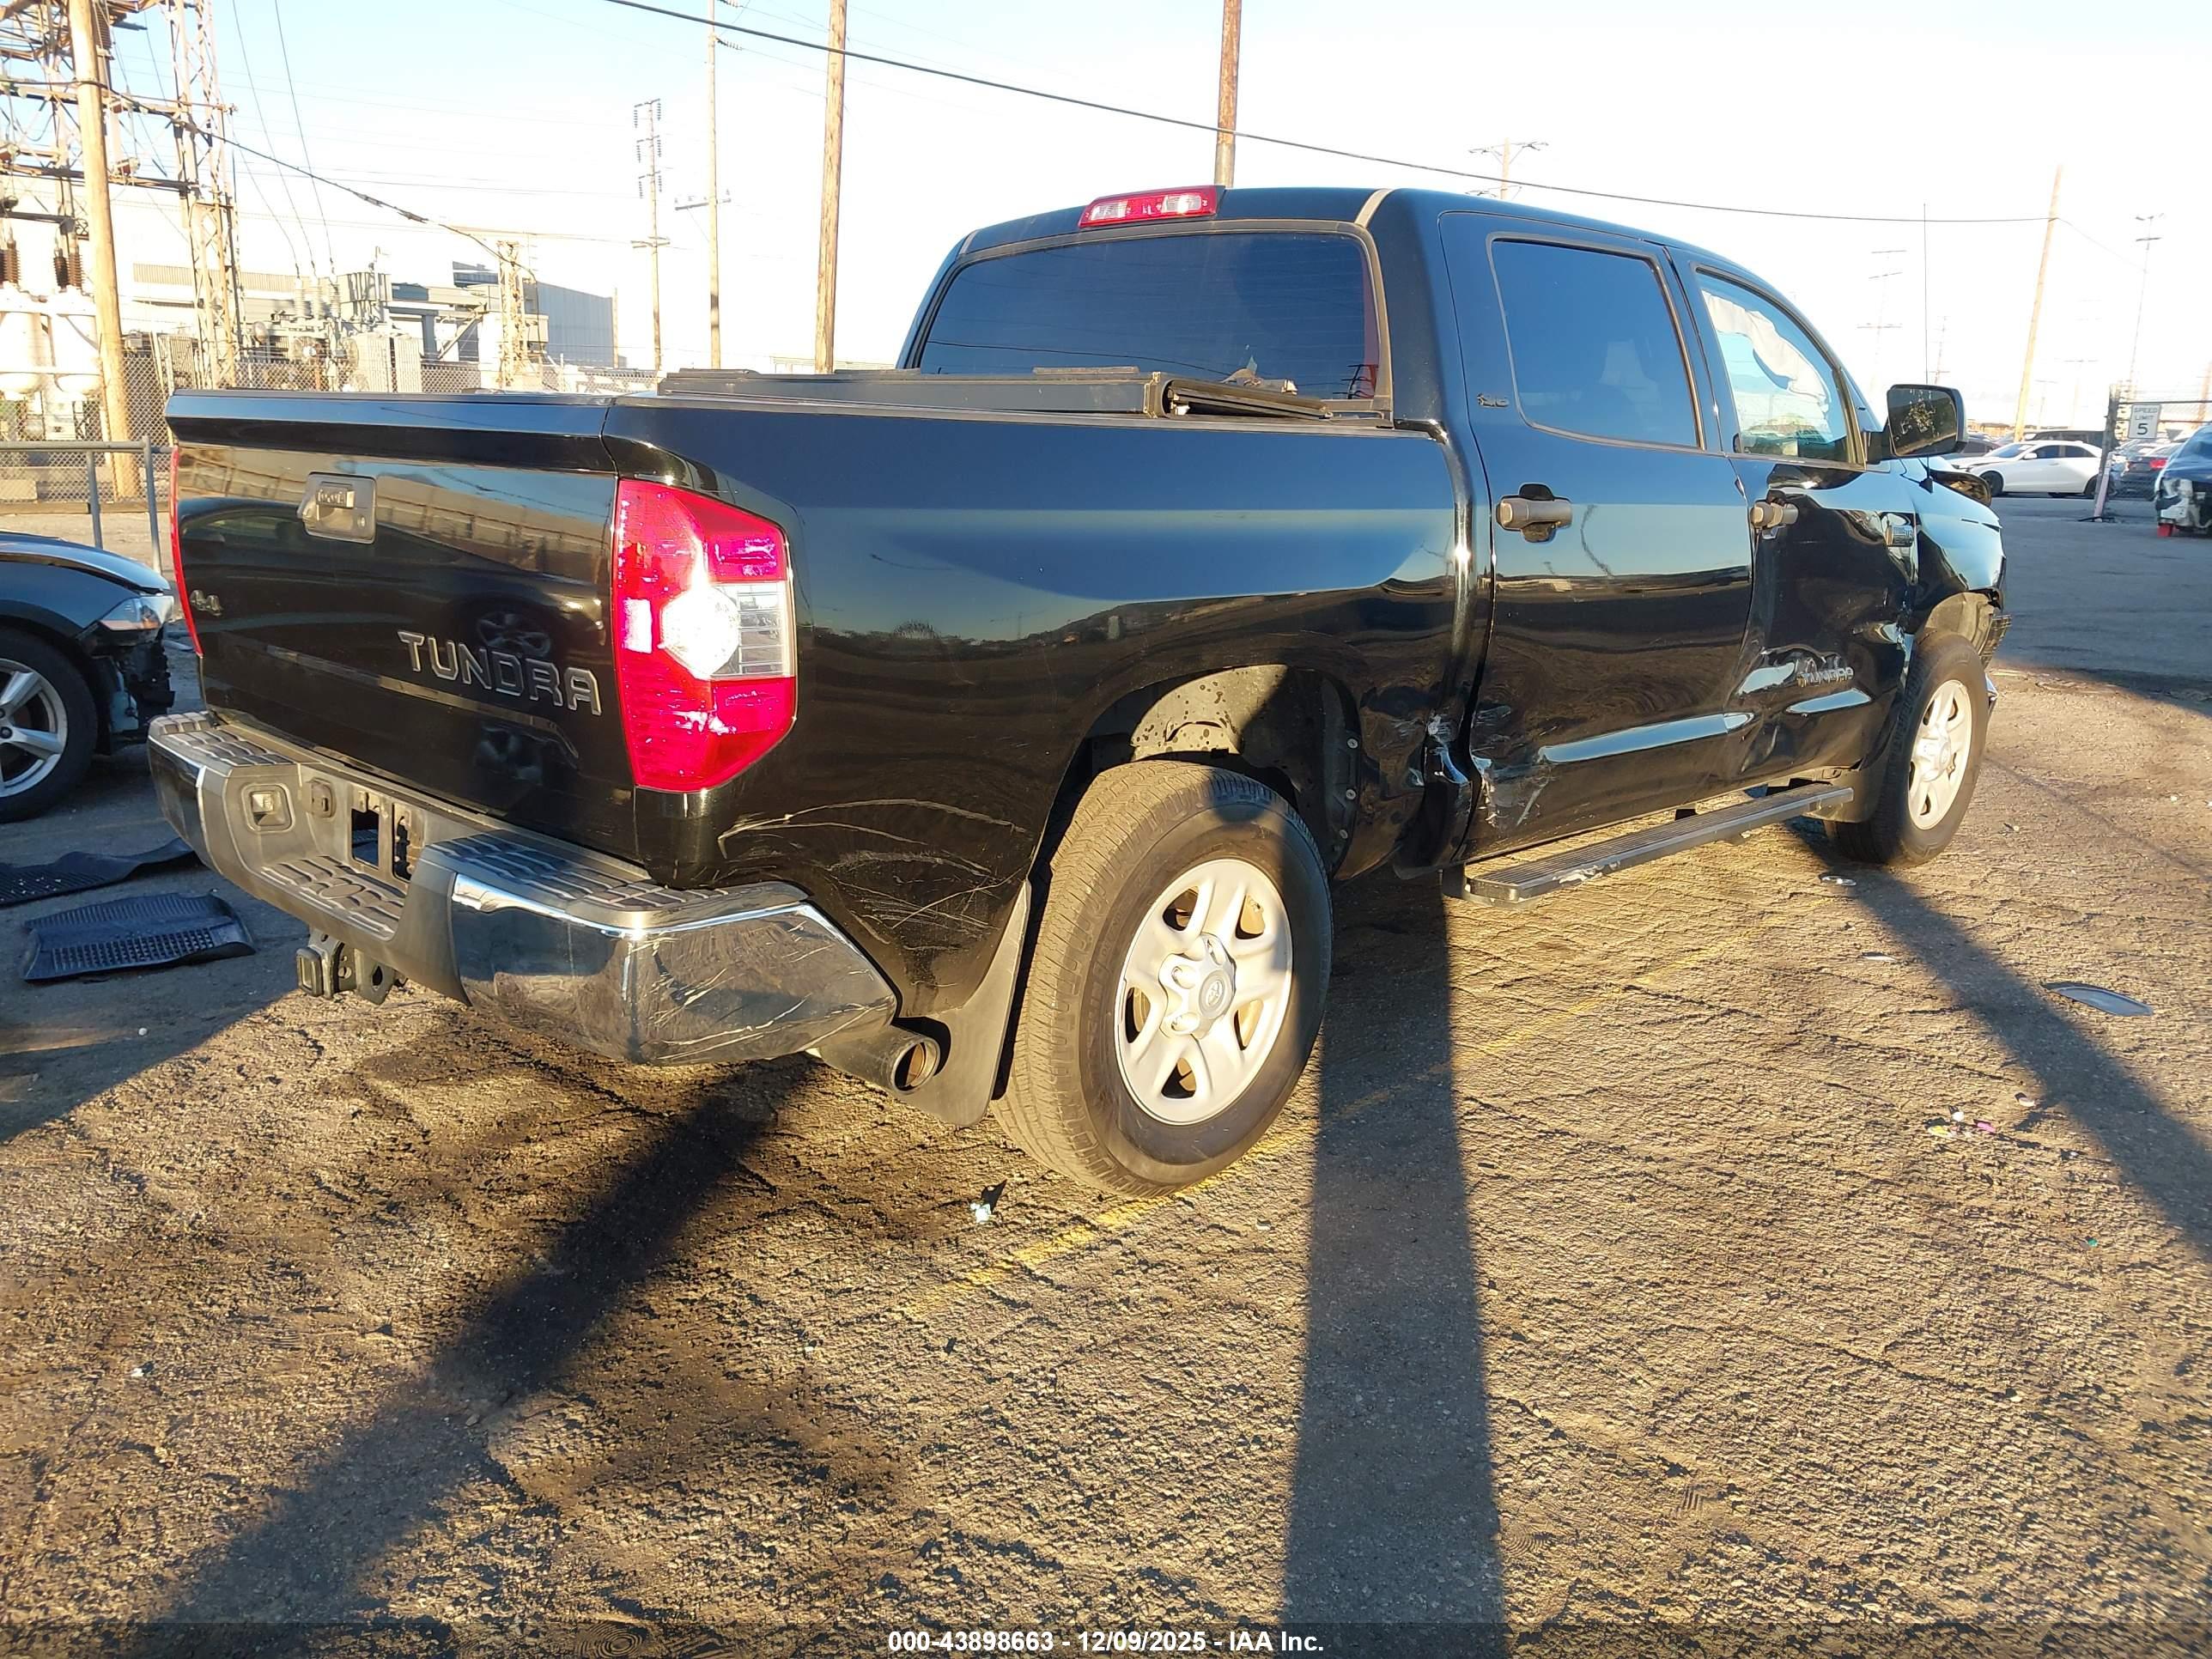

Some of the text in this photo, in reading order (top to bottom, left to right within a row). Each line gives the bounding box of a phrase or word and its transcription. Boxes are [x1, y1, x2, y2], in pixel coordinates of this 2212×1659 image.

[2136, 422, 2148, 435] 5
[397, 629, 602, 716] TUNDRA
[1796, 666, 1854, 688] TUNDRA
